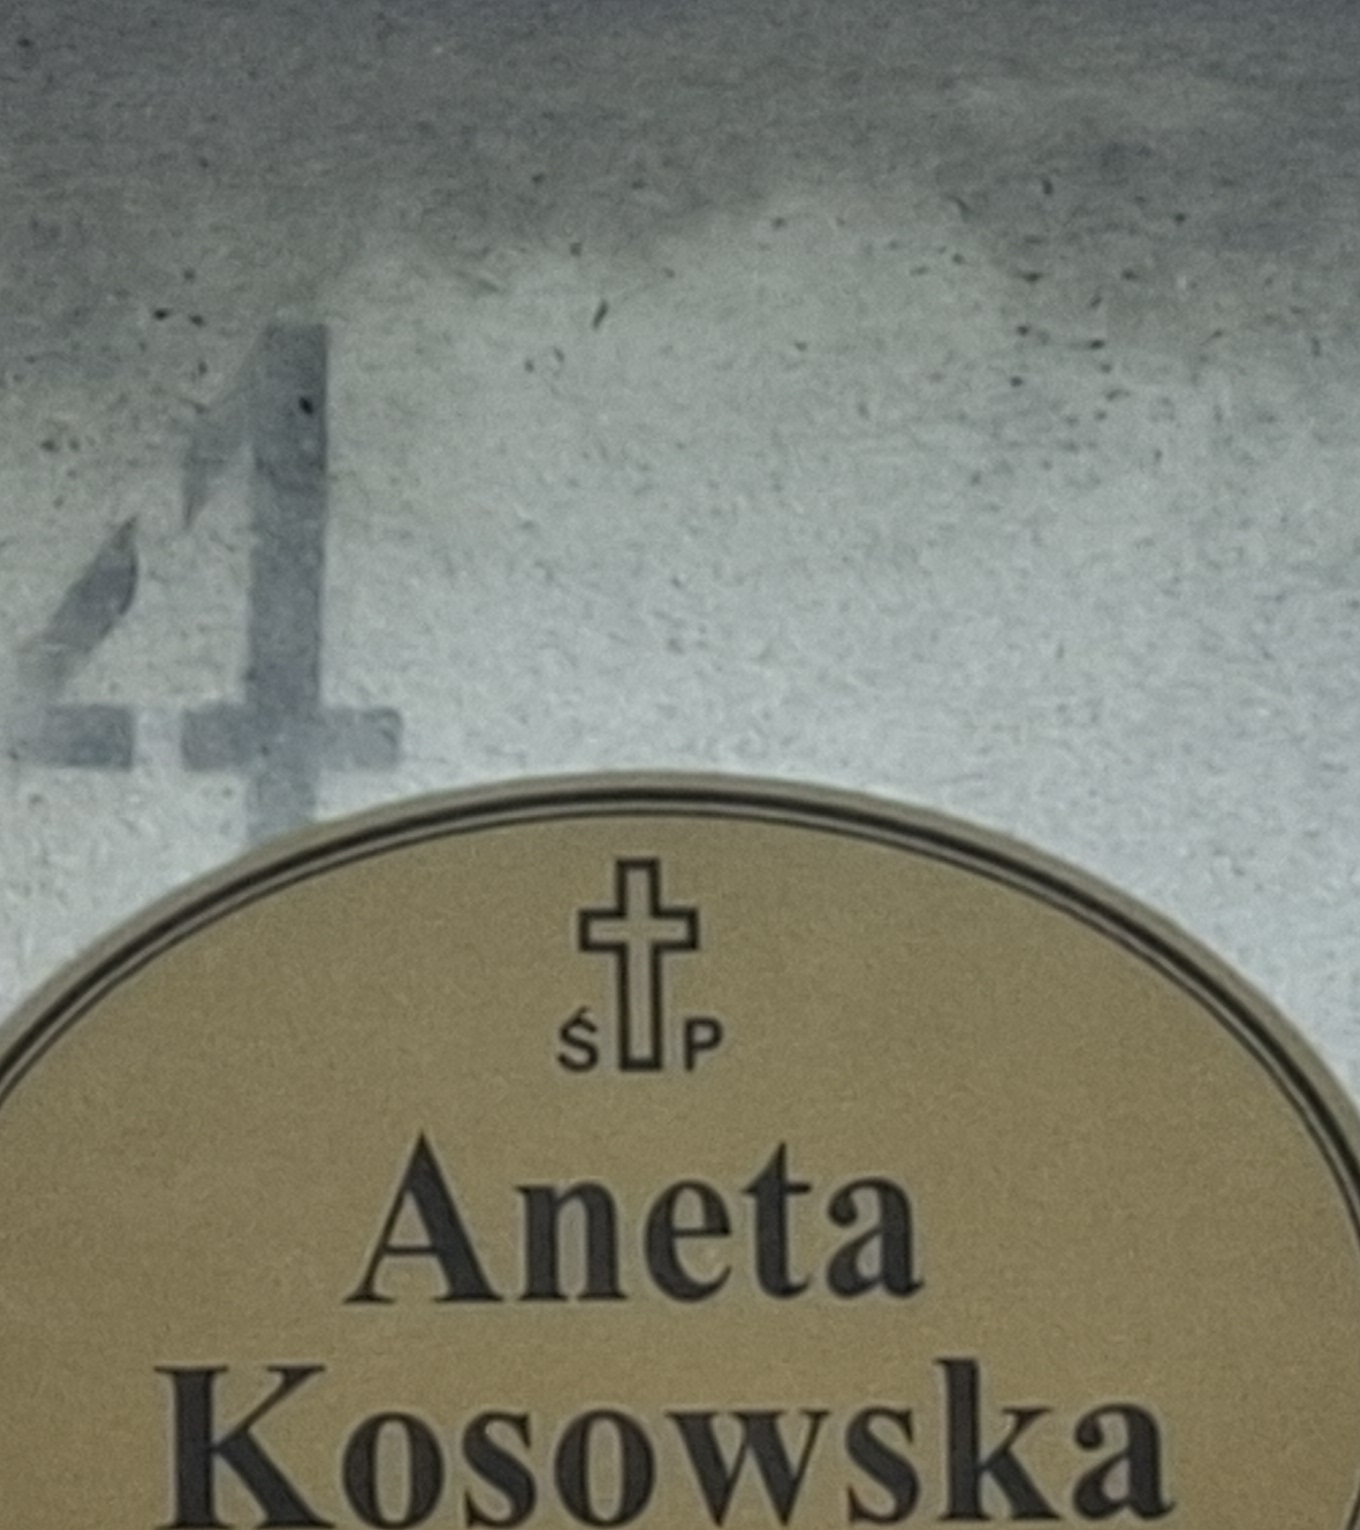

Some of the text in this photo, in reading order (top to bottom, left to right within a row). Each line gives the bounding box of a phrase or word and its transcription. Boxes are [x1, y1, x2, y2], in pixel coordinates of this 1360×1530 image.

[557, 1006, 724, 1073] Ś P
[343, 1132, 925, 1305] Aneta
